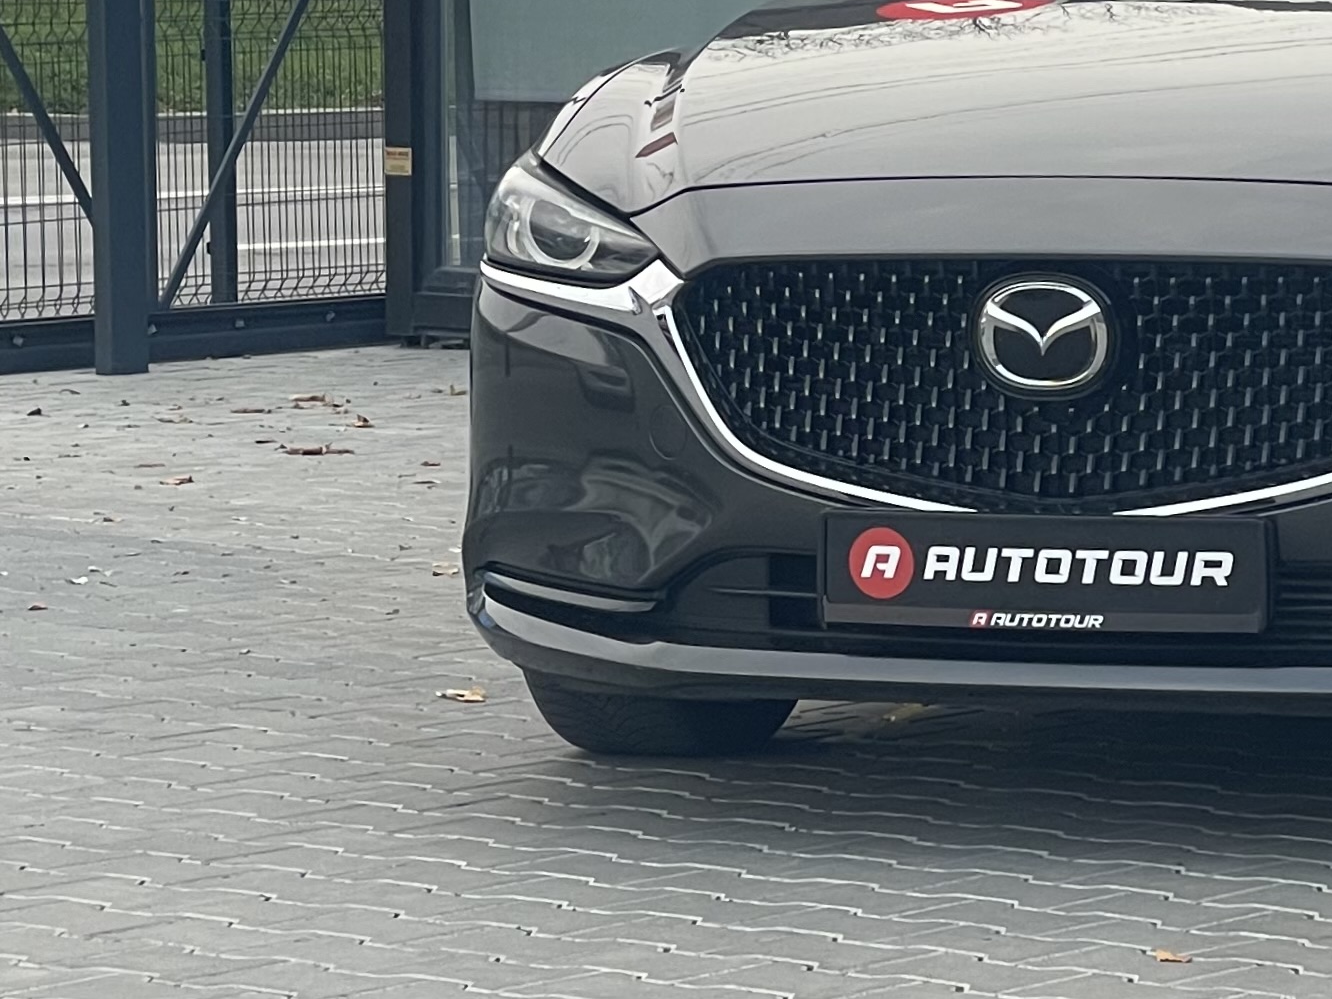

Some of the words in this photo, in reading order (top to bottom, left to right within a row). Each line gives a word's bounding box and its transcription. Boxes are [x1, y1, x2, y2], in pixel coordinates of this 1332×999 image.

[860, 545, 901, 579] A
[923, 545, 1235, 587] AUTOTOUR
[972, 612, 988, 626] A
[990, 612, 1104, 629] AUTOTOUR
